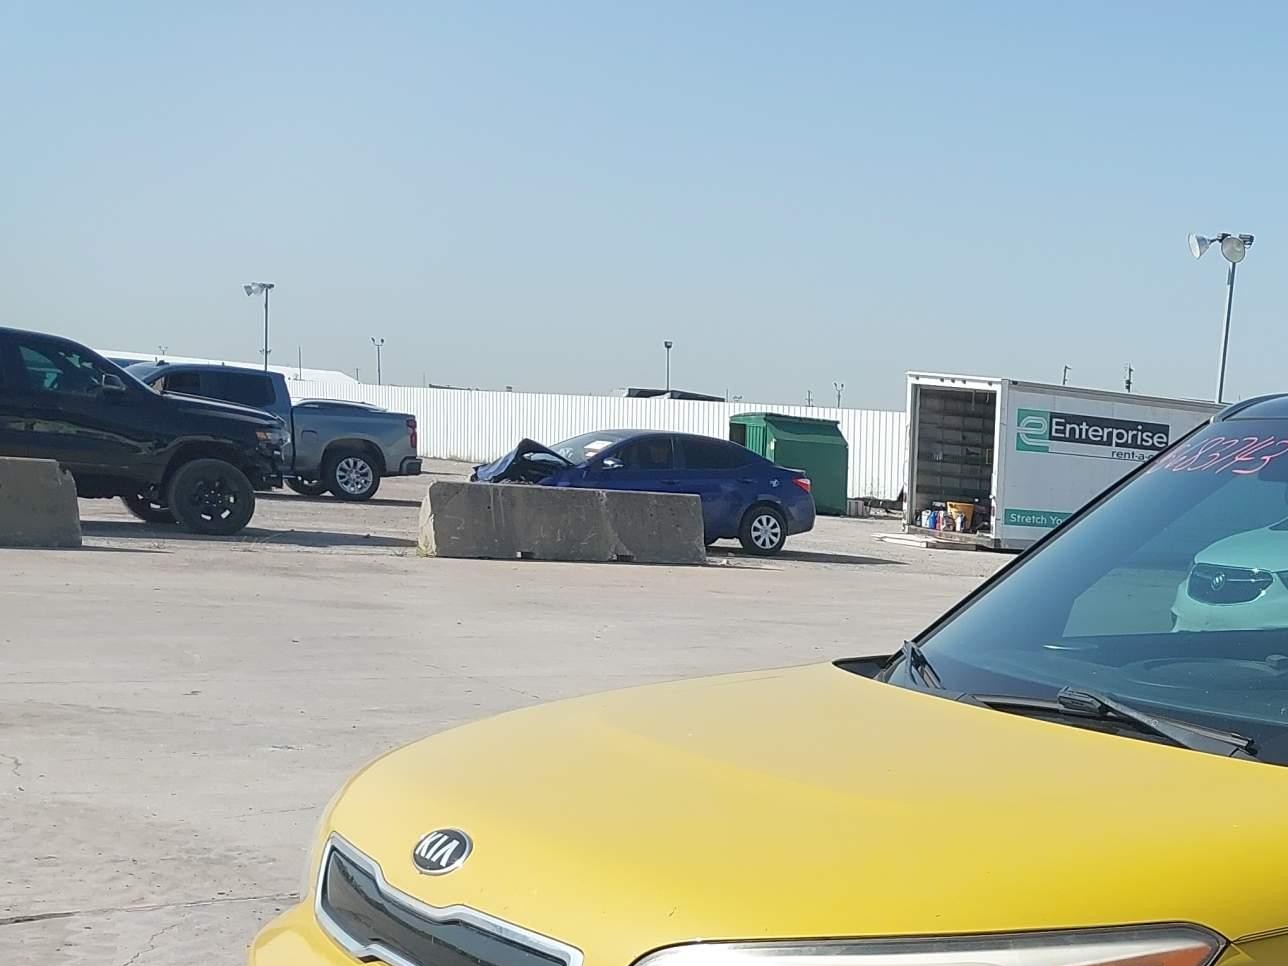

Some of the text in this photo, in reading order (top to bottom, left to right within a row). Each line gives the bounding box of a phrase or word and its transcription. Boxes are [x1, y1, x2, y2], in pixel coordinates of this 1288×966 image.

[1051, 418, 1168, 448] Enterprise
[1010, 513, 1047, 525] Stretch
[415, 831, 461, 868] KIA
